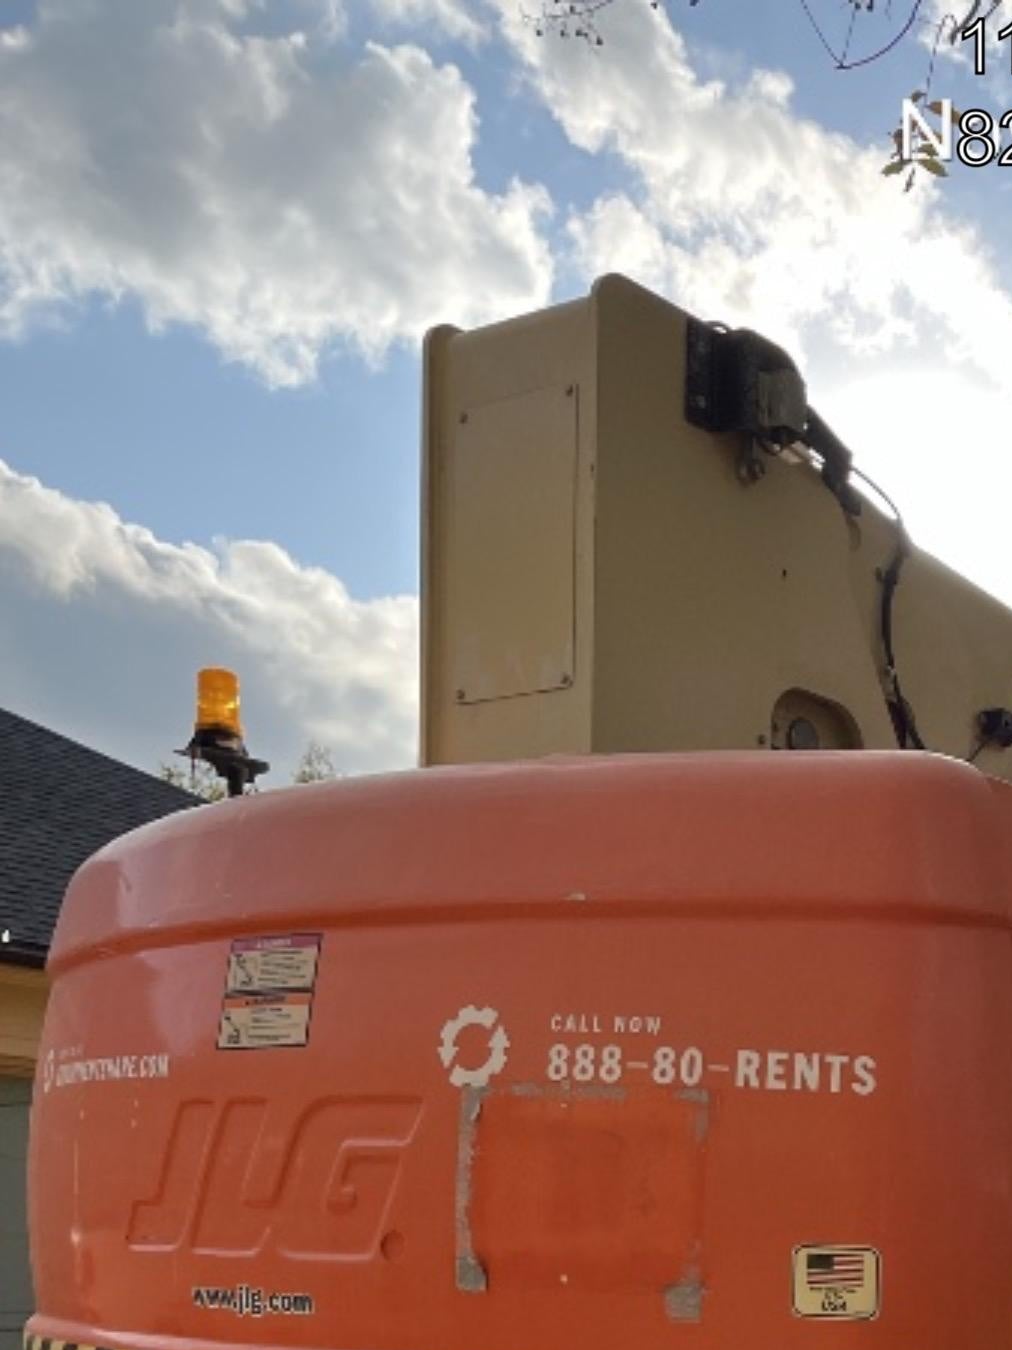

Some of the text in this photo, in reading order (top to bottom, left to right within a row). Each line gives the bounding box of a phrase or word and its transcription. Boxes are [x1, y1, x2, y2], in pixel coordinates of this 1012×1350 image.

[551, 1014, 662, 1036] CALL NOW
[547, 1043, 877, 1096] 888-80-RENTS
[126, 1093, 424, 1262] JLG
[192, 1284, 315, 1318] www.jlg.com
